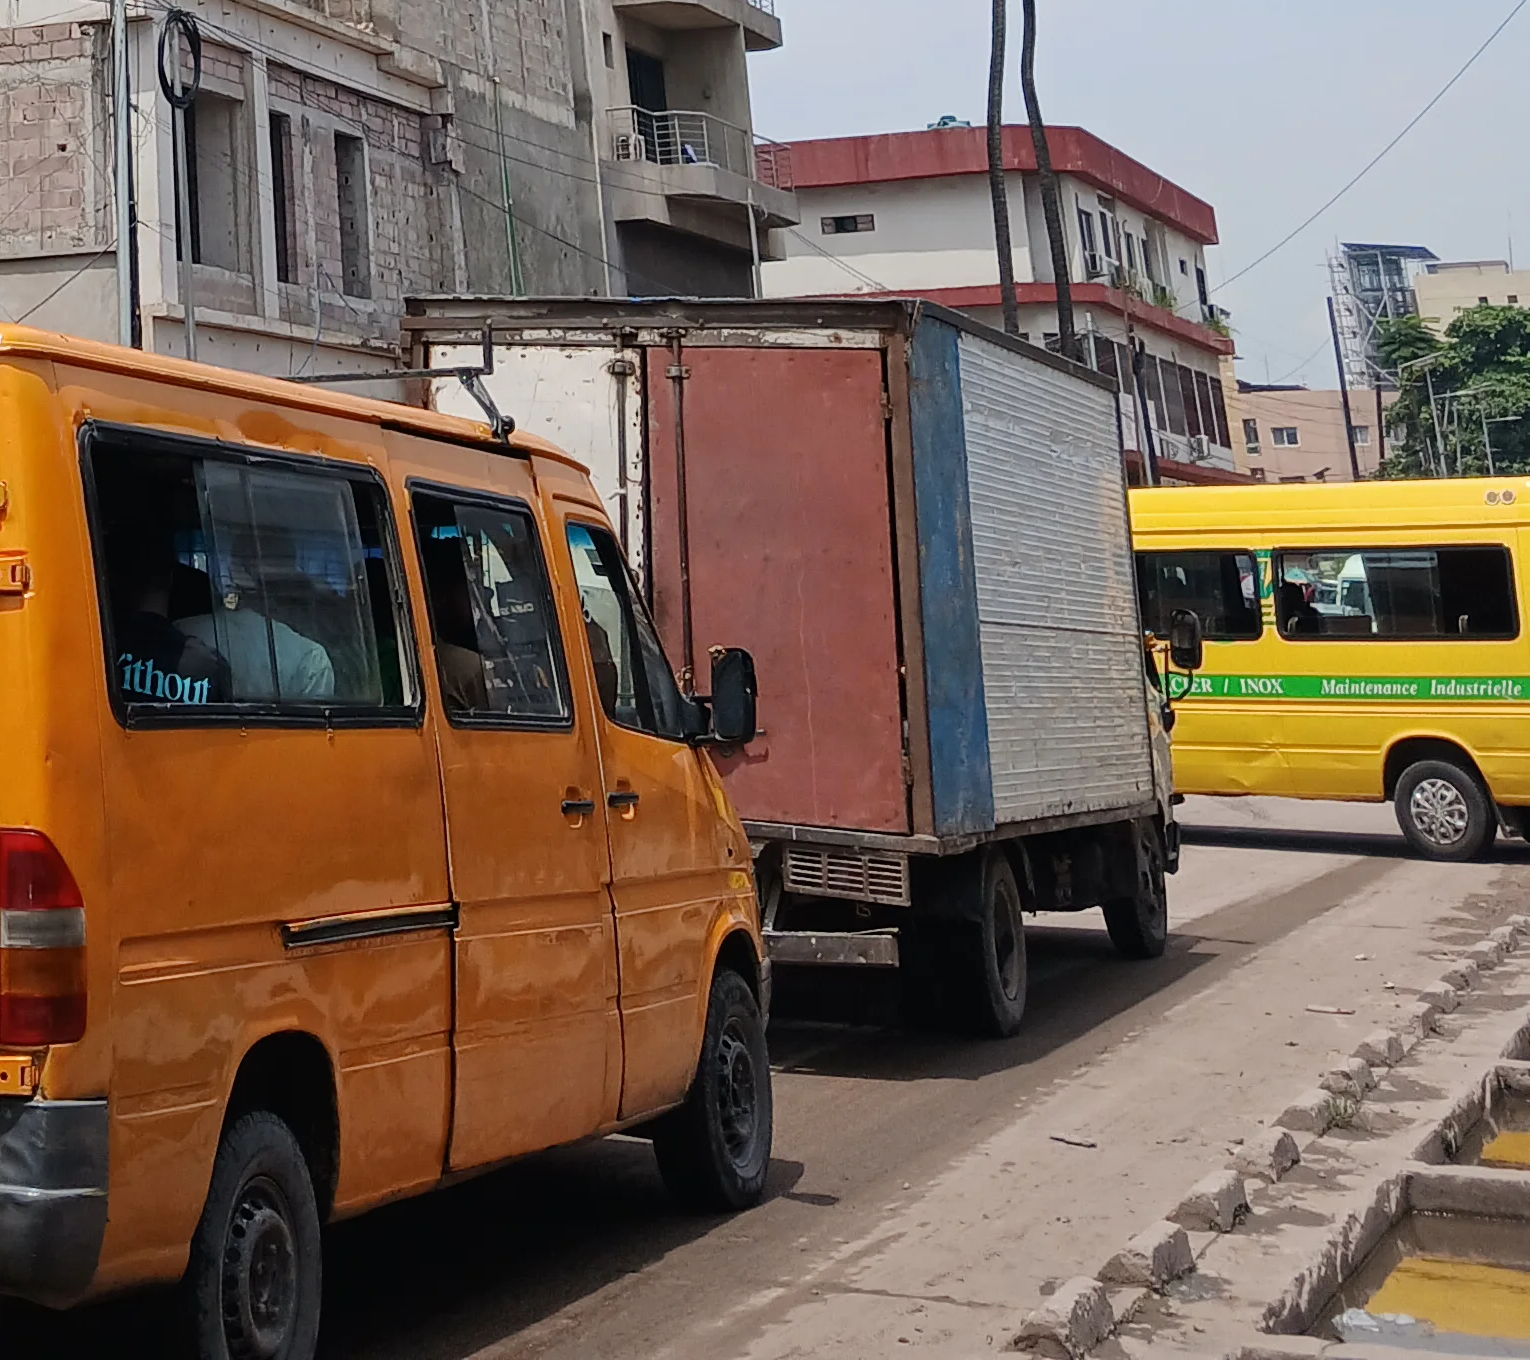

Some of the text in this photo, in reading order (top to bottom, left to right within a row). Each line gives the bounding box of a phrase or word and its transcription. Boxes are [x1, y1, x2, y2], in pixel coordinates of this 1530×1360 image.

[1168, 677, 1213, 694] CIER
[1240, 677, 1284, 694] INOX
[1320, 678, 1418, 696] Maintenance
[1429, 679, 1522, 697] Industrielle
